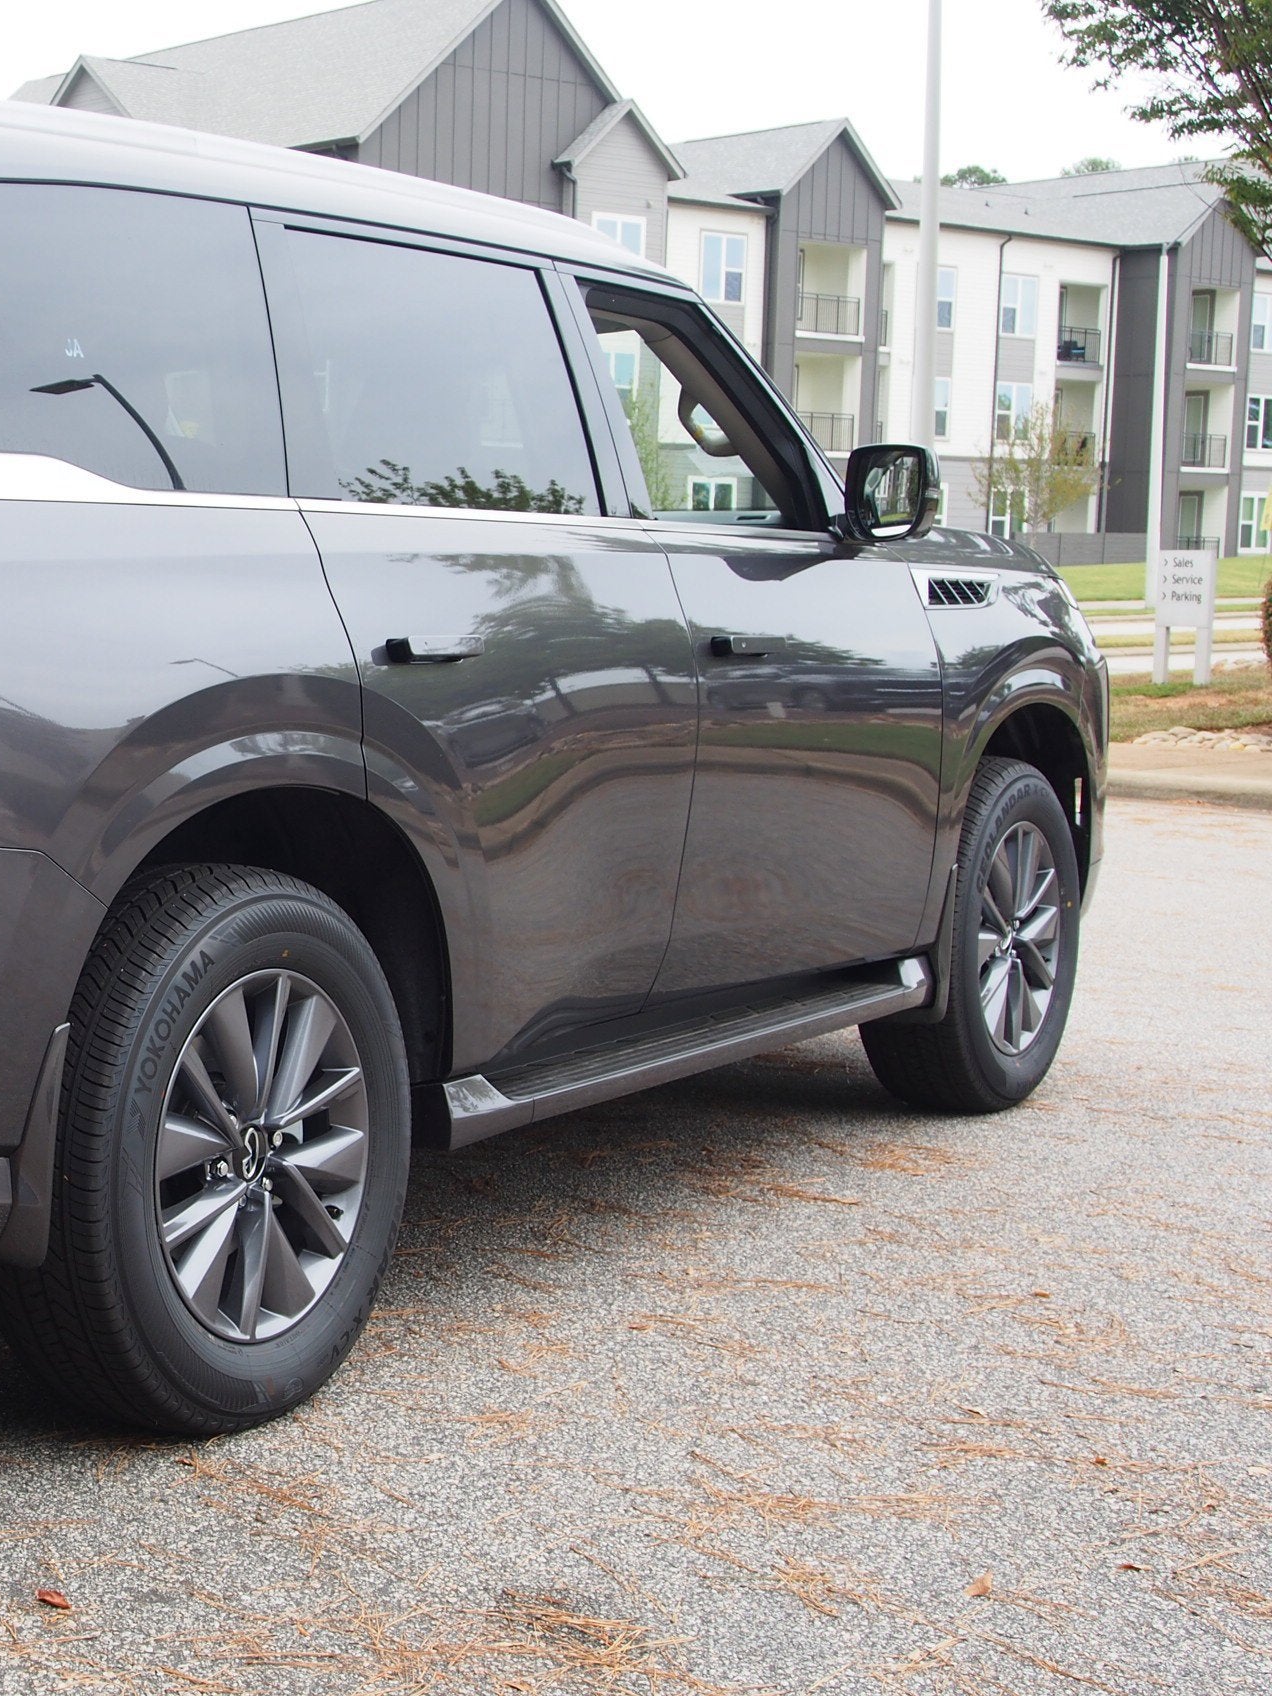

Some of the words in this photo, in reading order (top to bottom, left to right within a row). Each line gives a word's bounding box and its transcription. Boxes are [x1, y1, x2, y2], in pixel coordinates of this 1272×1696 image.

[1173, 557, 1194, 568] Sales
[1172, 574, 1203, 585] Service
[1171, 590, 1202, 604] Parking
[135, 949, 216, 1094] YOKOHAMA
